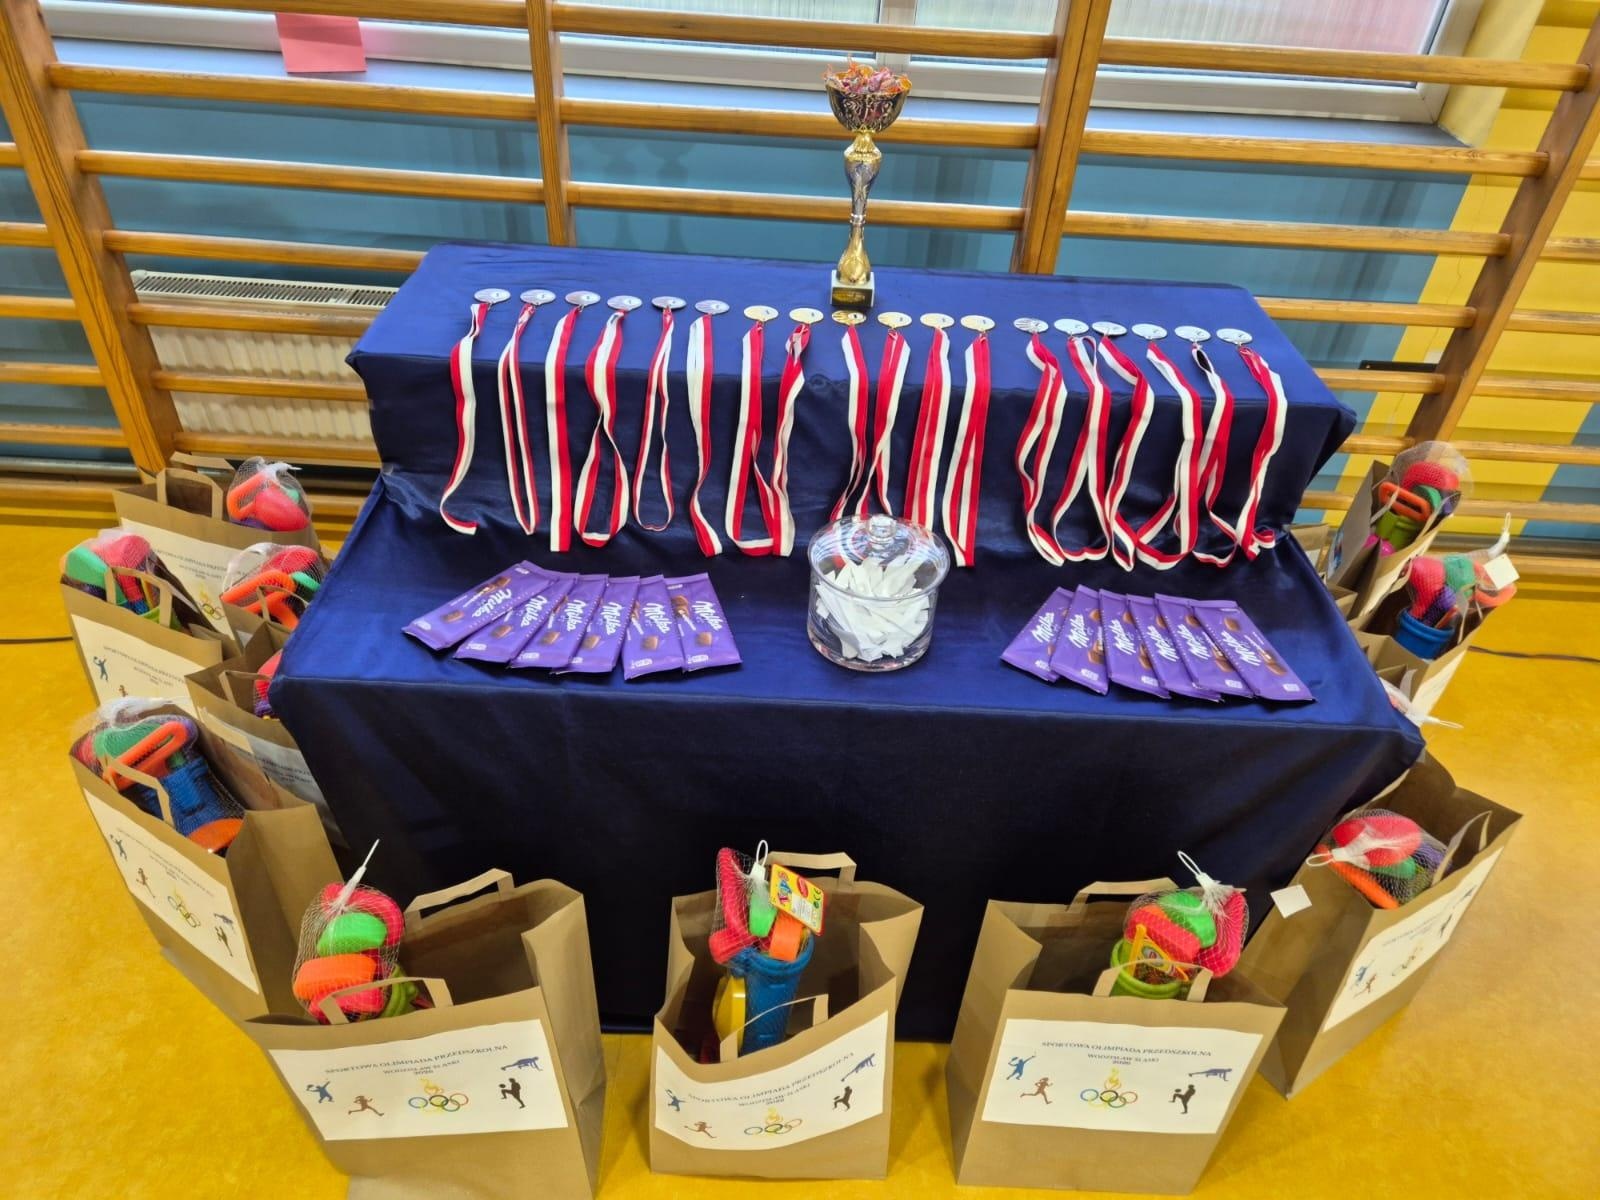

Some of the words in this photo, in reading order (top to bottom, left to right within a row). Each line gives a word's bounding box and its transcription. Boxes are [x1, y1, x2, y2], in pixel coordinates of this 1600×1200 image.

[472, 588, 512, 617] Milka
[521, 595, 547, 627] Milka
[564, 599, 586, 631] Milka
[601, 602, 623, 635] Milka
[643, 603, 672, 634] Milka
[692, 601, 724, 631] Milka
[1031, 612, 1054, 643] Milka
[1067, 614, 1090, 649] Milka
[1108, 619, 1136, 655] Milka
[1147, 625, 1179, 662] Milka
[1177, 623, 1211, 660] Milka
[1221, 630, 1261, 666] Milka
[1091, 1044, 1141, 1054] OLIMPIADA
